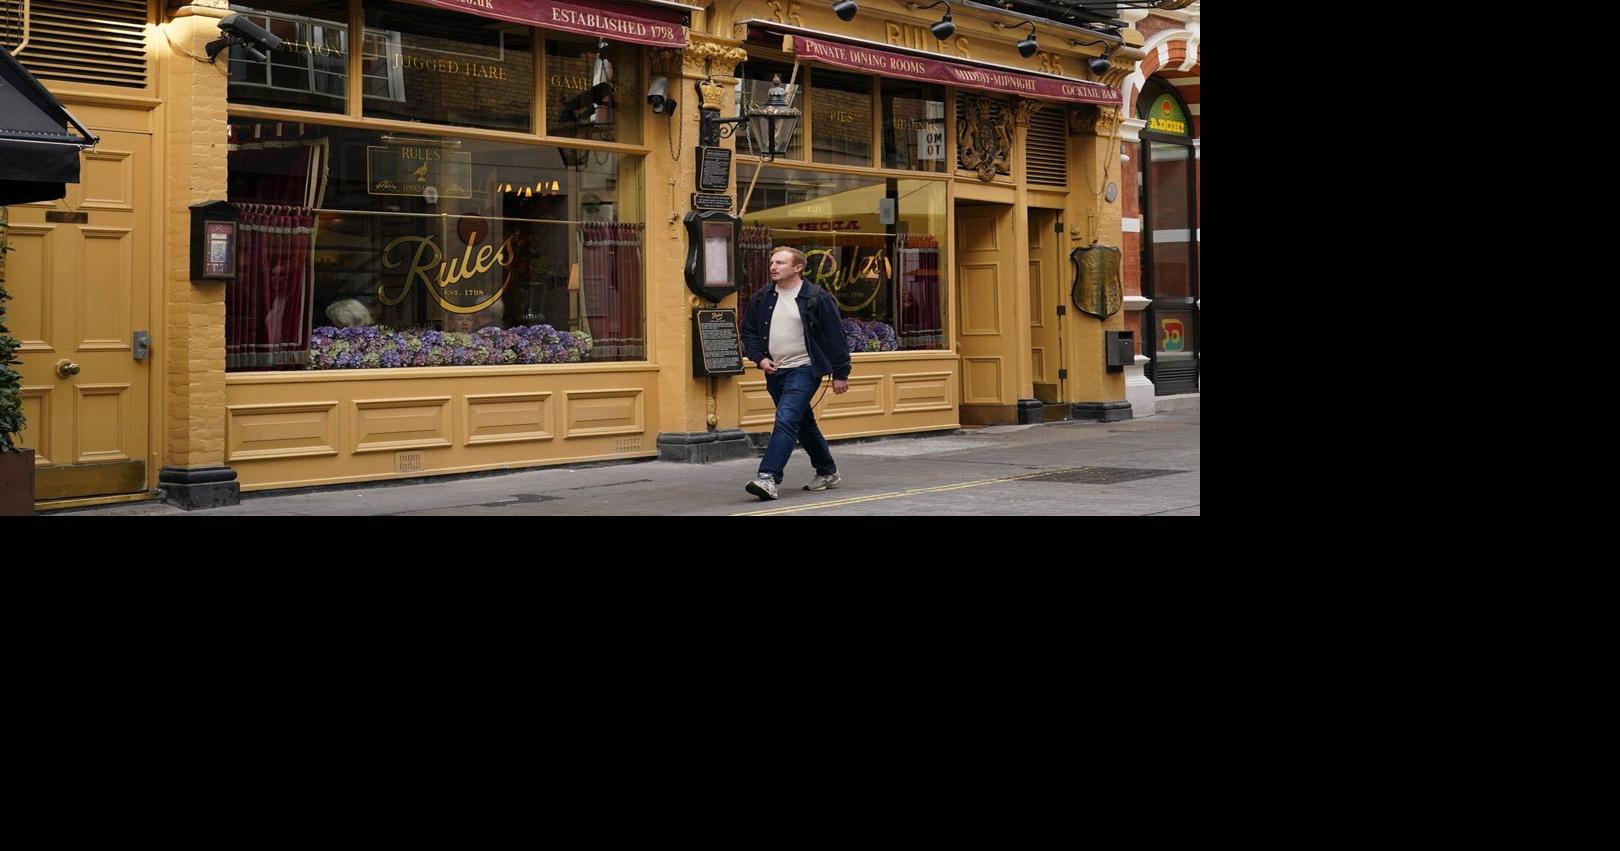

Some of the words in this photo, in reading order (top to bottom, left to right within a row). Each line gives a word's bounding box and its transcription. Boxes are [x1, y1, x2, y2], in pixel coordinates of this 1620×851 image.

[552, 7, 646, 36] ESTABLISHED
[651, 26, 674, 40] 1798
[279, 38, 343, 58] ALMON
[804, 39, 847, 60] PRIVATE
[850, 49, 887, 68] DINING
[890, 57, 926, 74] ROOMS
[393, 53, 459, 74] JUGGED
[466, 62, 507, 80] HARE
[1061, 84, 1100, 98] COCKTAIL
[1102, 88, 1119, 99] BAR
[887, 118, 939, 134] UDDINGS
[402, 147, 441, 161] RULES
[378, 231, 514, 314] Rules
[803, 245, 884, 312] Rules
